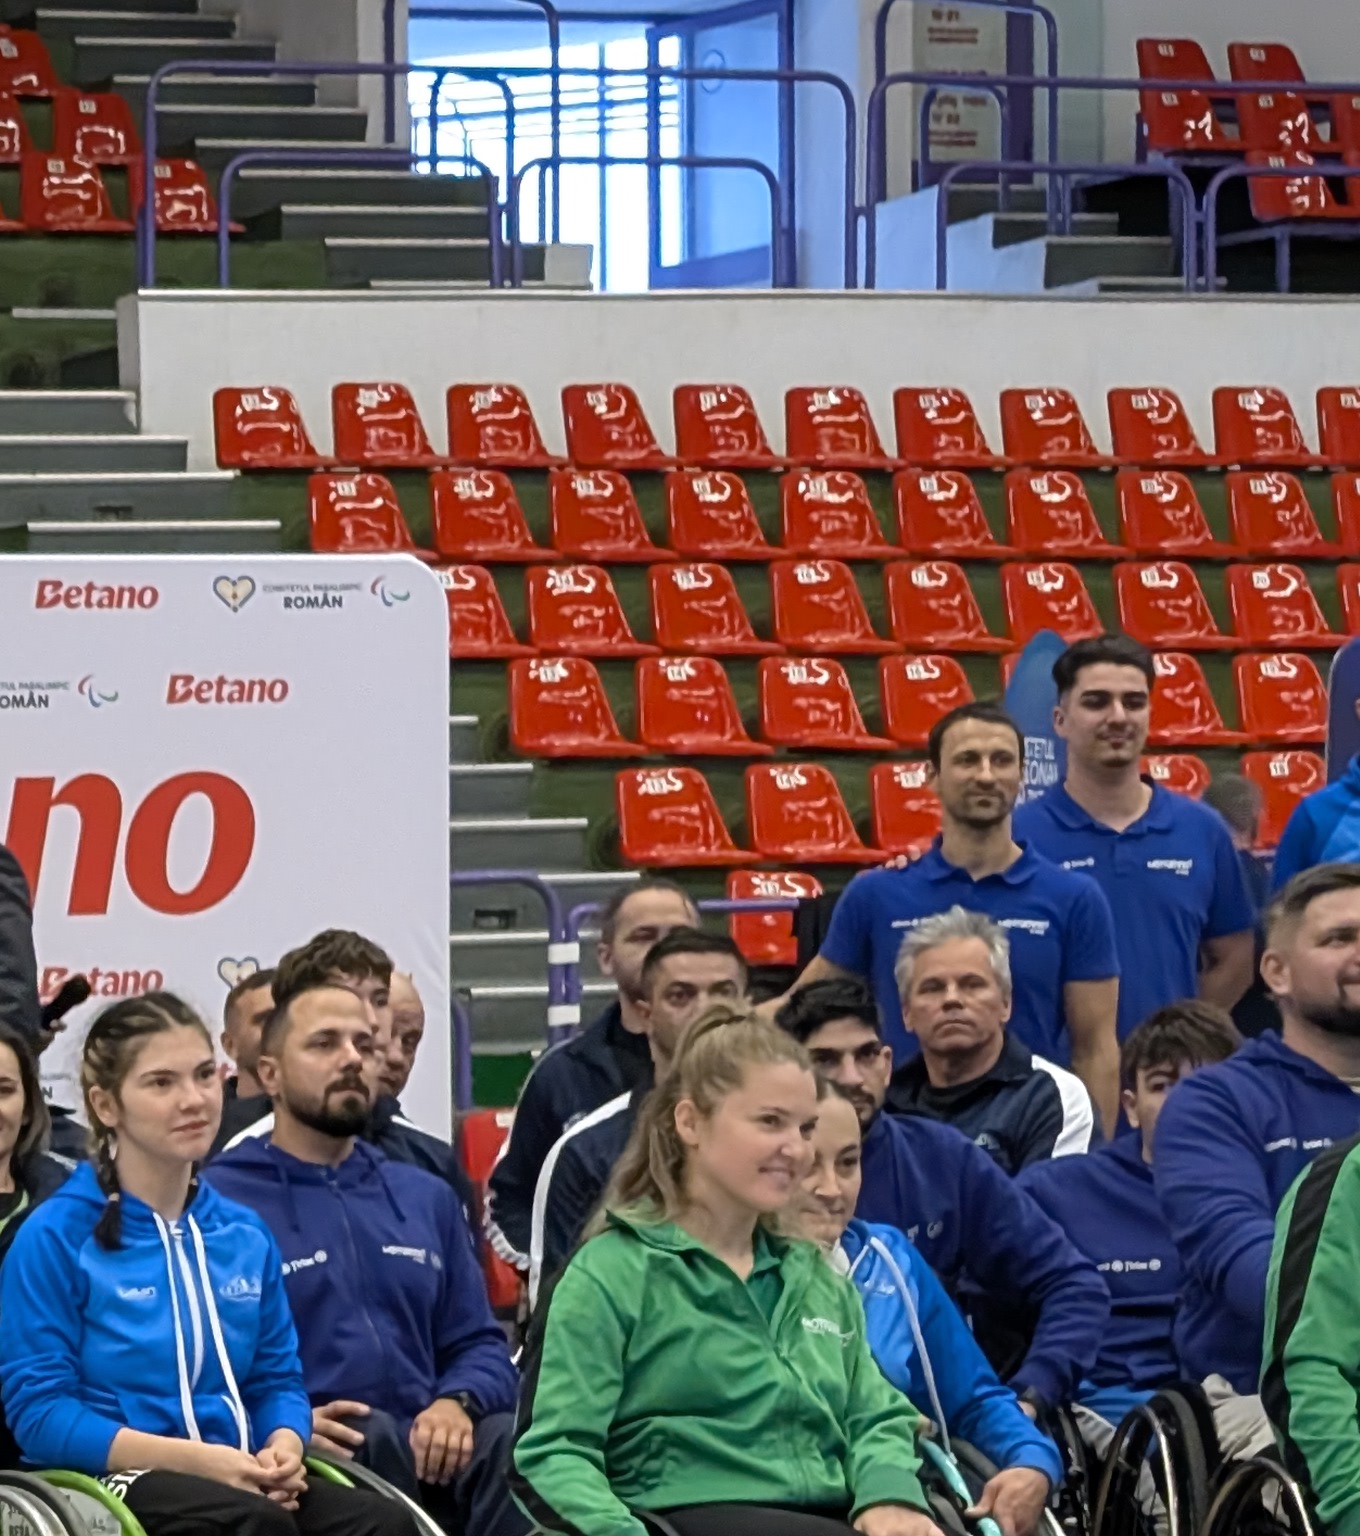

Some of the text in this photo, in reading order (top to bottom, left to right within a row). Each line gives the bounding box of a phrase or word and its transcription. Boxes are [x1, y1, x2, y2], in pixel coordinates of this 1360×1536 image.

[34, 579, 160, 610] Betano
[165, 673, 290, 705] Betano
[40, 966, 165, 998] Btano
